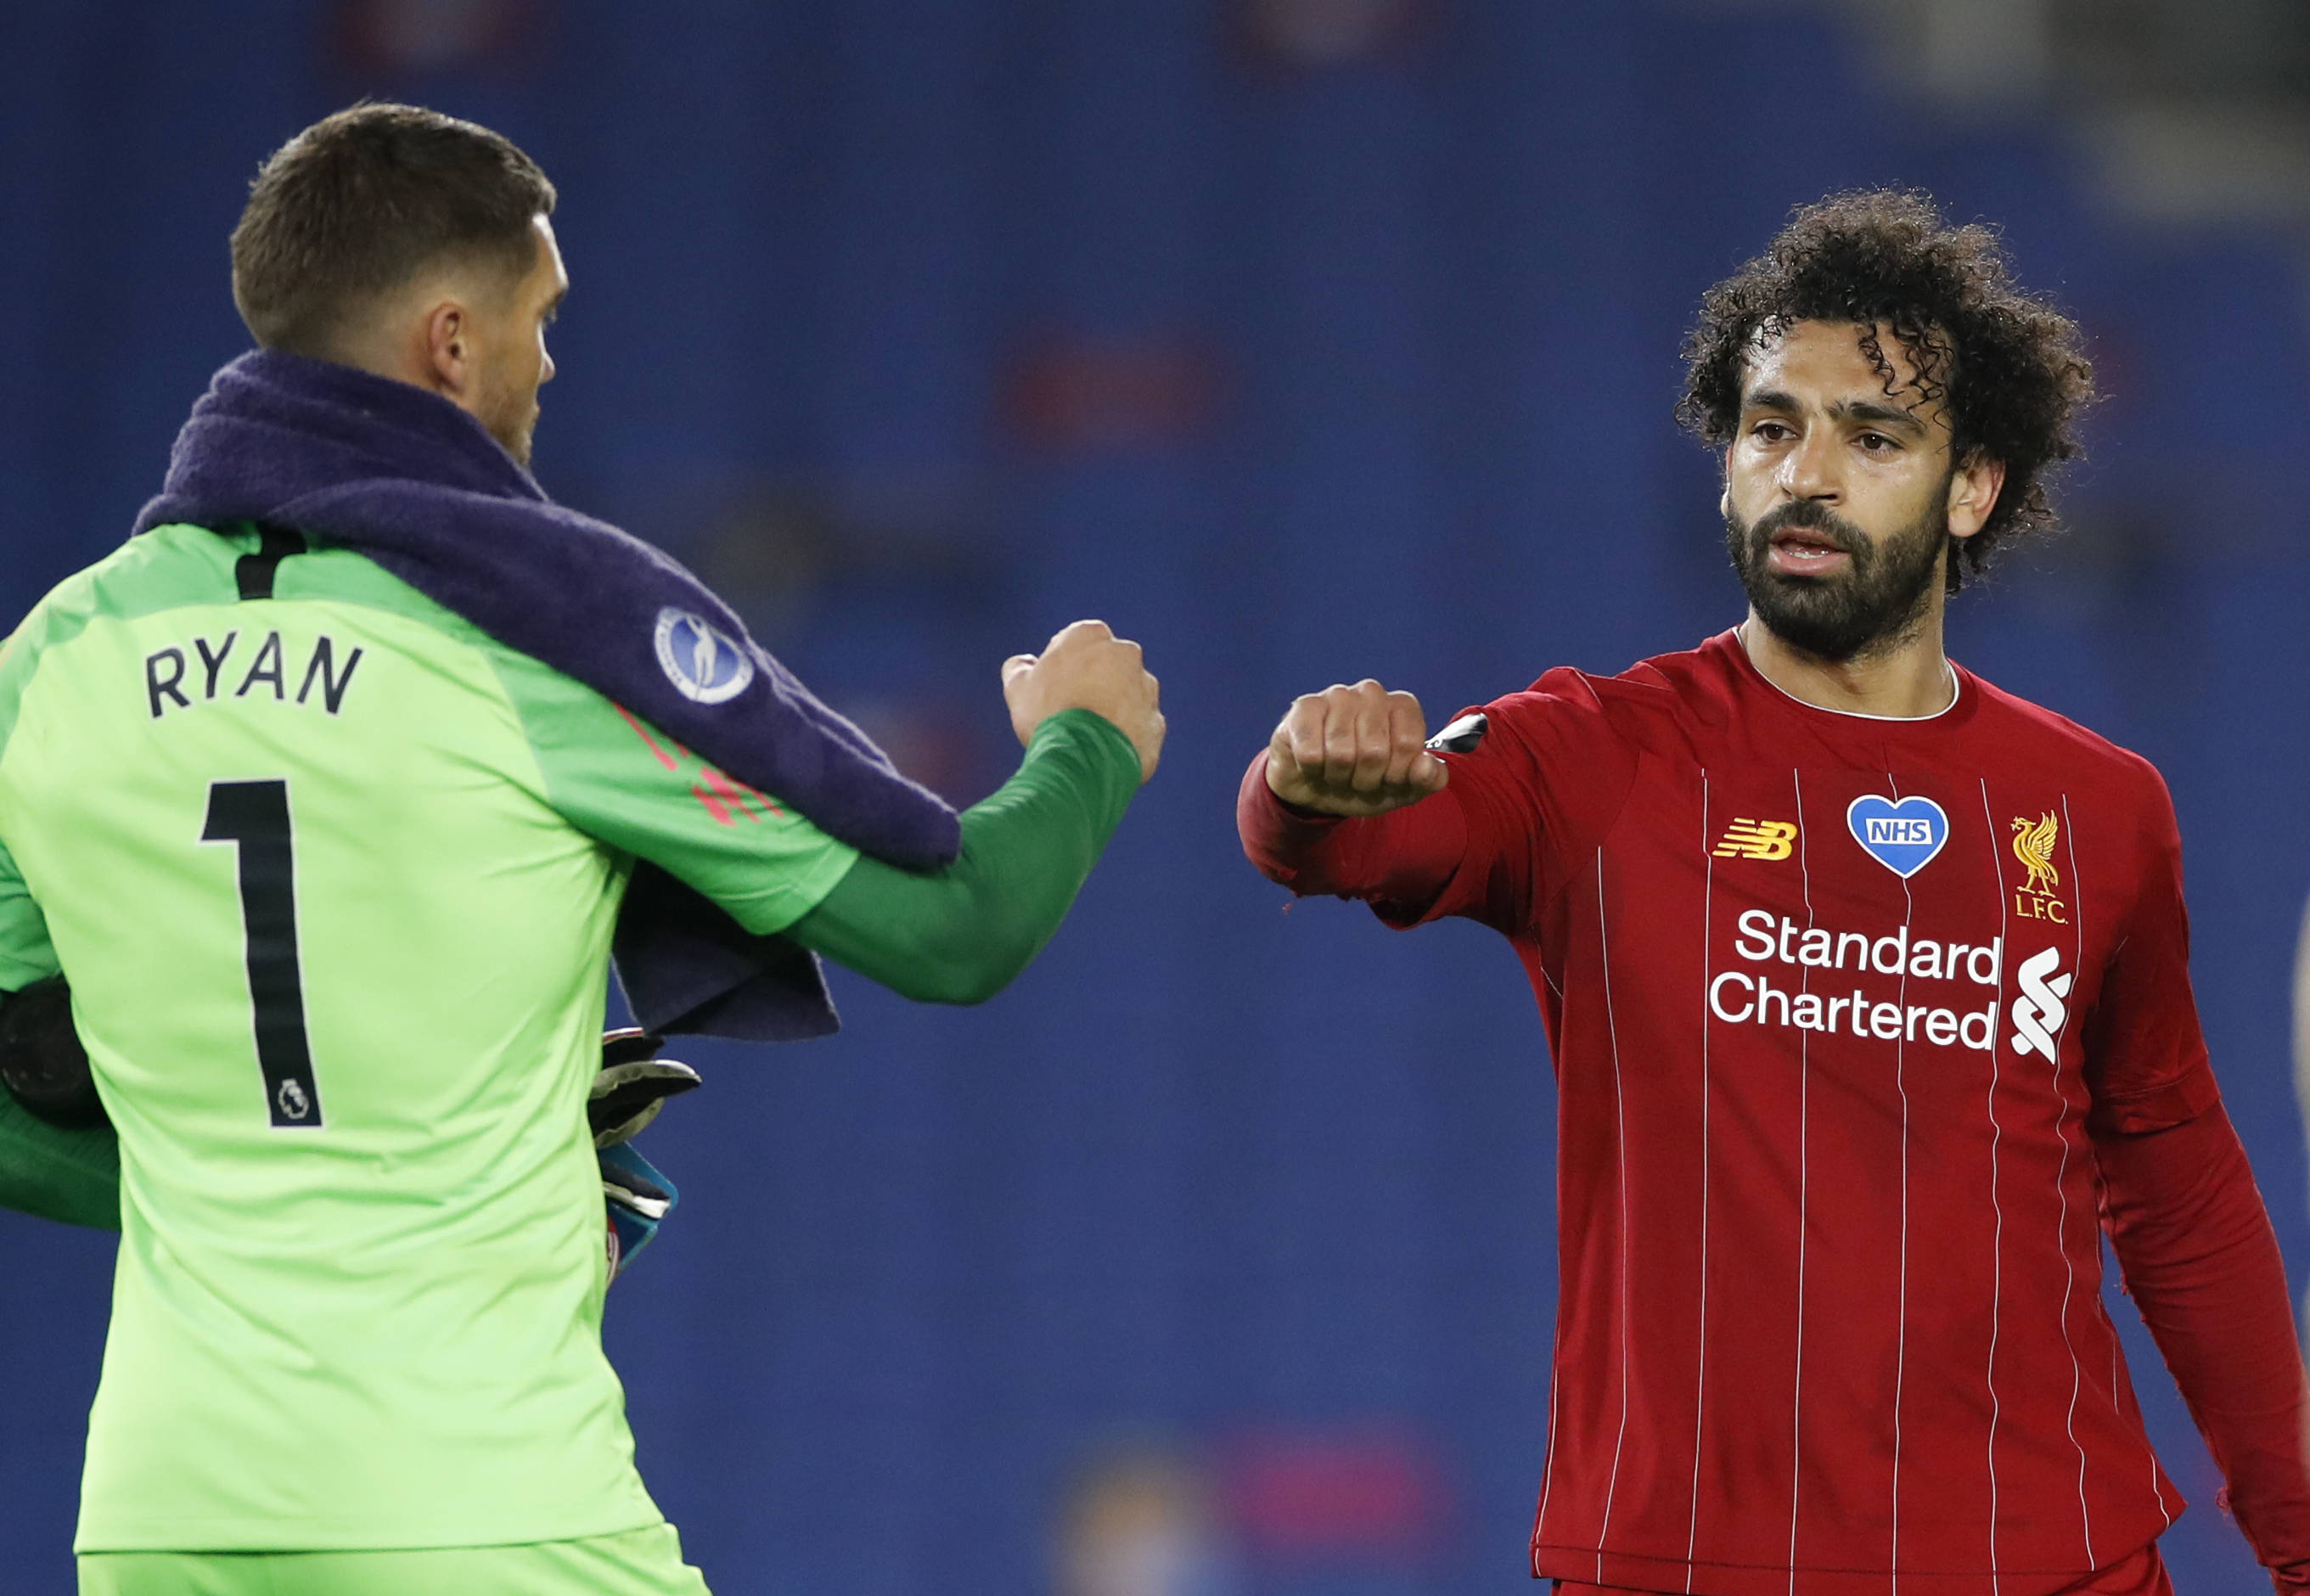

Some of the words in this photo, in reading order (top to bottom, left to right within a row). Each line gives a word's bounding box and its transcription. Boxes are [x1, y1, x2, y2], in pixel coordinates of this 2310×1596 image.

[145, 630, 363, 718] RYAN
[1871, 821, 1927, 842] NHS
[198, 778, 323, 1129] 1
[1734, 909, 2001, 986] Standard
[1708, 971, 1998, 1051] Chartered
